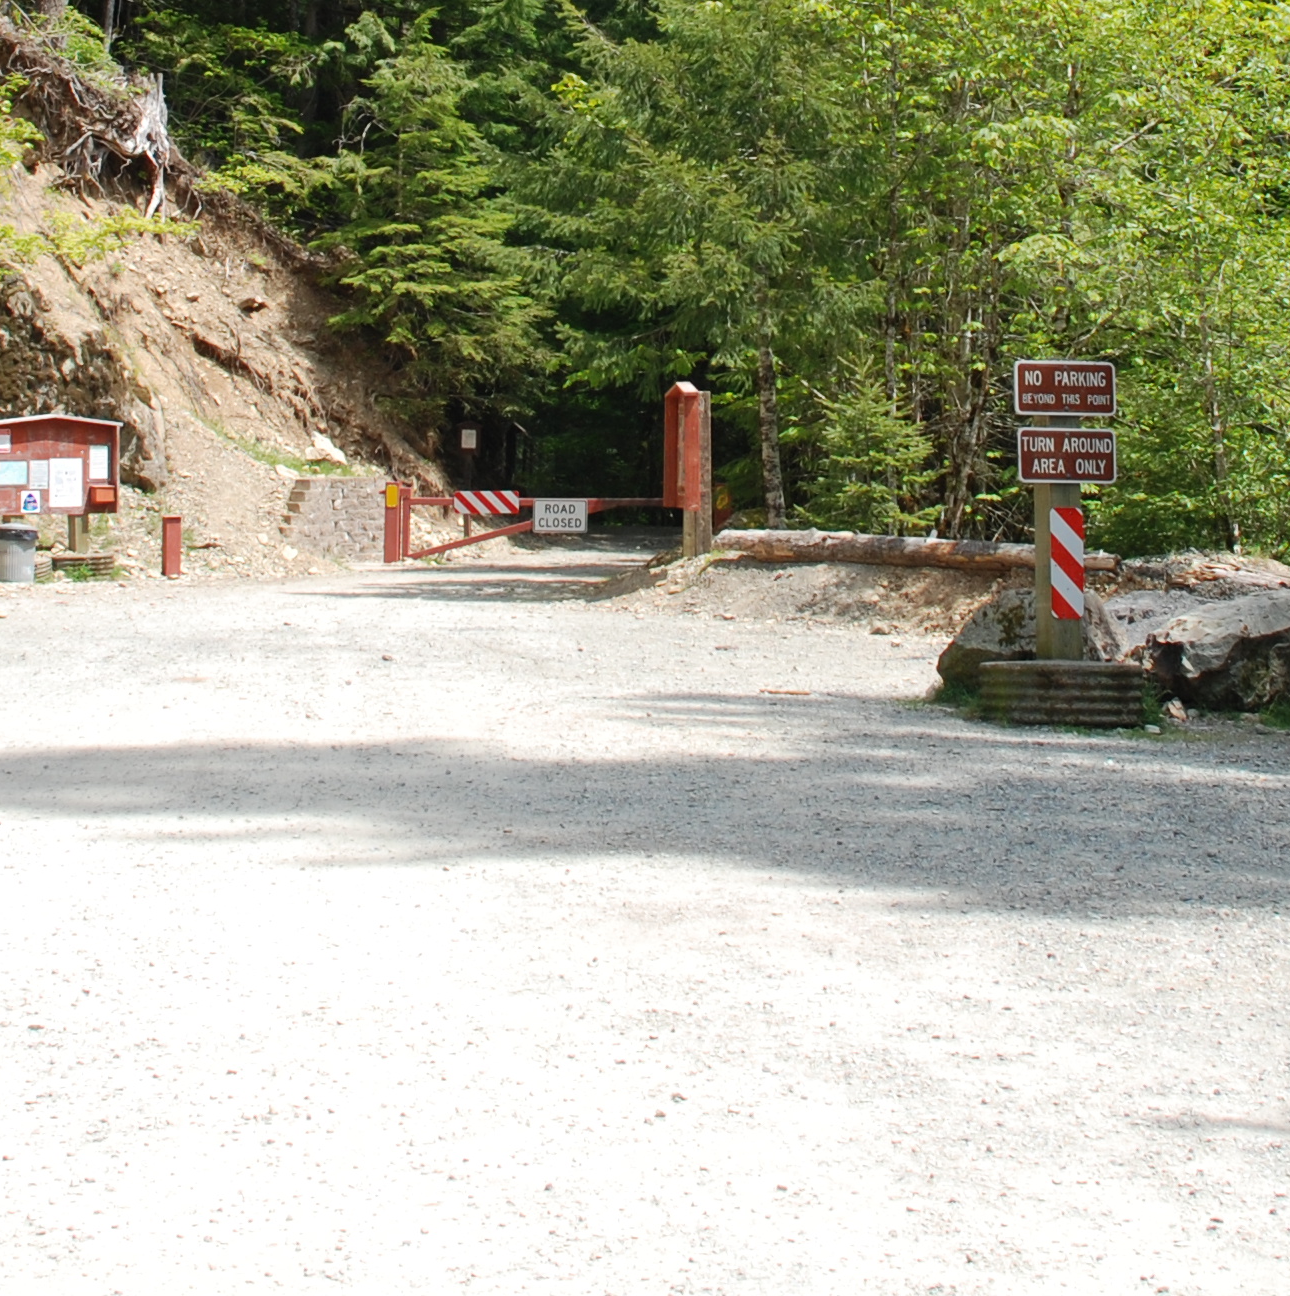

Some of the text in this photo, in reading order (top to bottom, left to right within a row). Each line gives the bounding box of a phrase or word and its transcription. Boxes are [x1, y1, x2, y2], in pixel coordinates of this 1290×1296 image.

[1024, 370, 1106, 387] NO PARKING
[1022, 393, 1111, 406] BEYOND THIS POINT
[1022, 437, 1112, 454] TURN AROUND
[1032, 458, 1106, 475] AREA ONLY
[544, 504, 576, 514] ROAD
[538, 517, 582, 528] CLOSED
